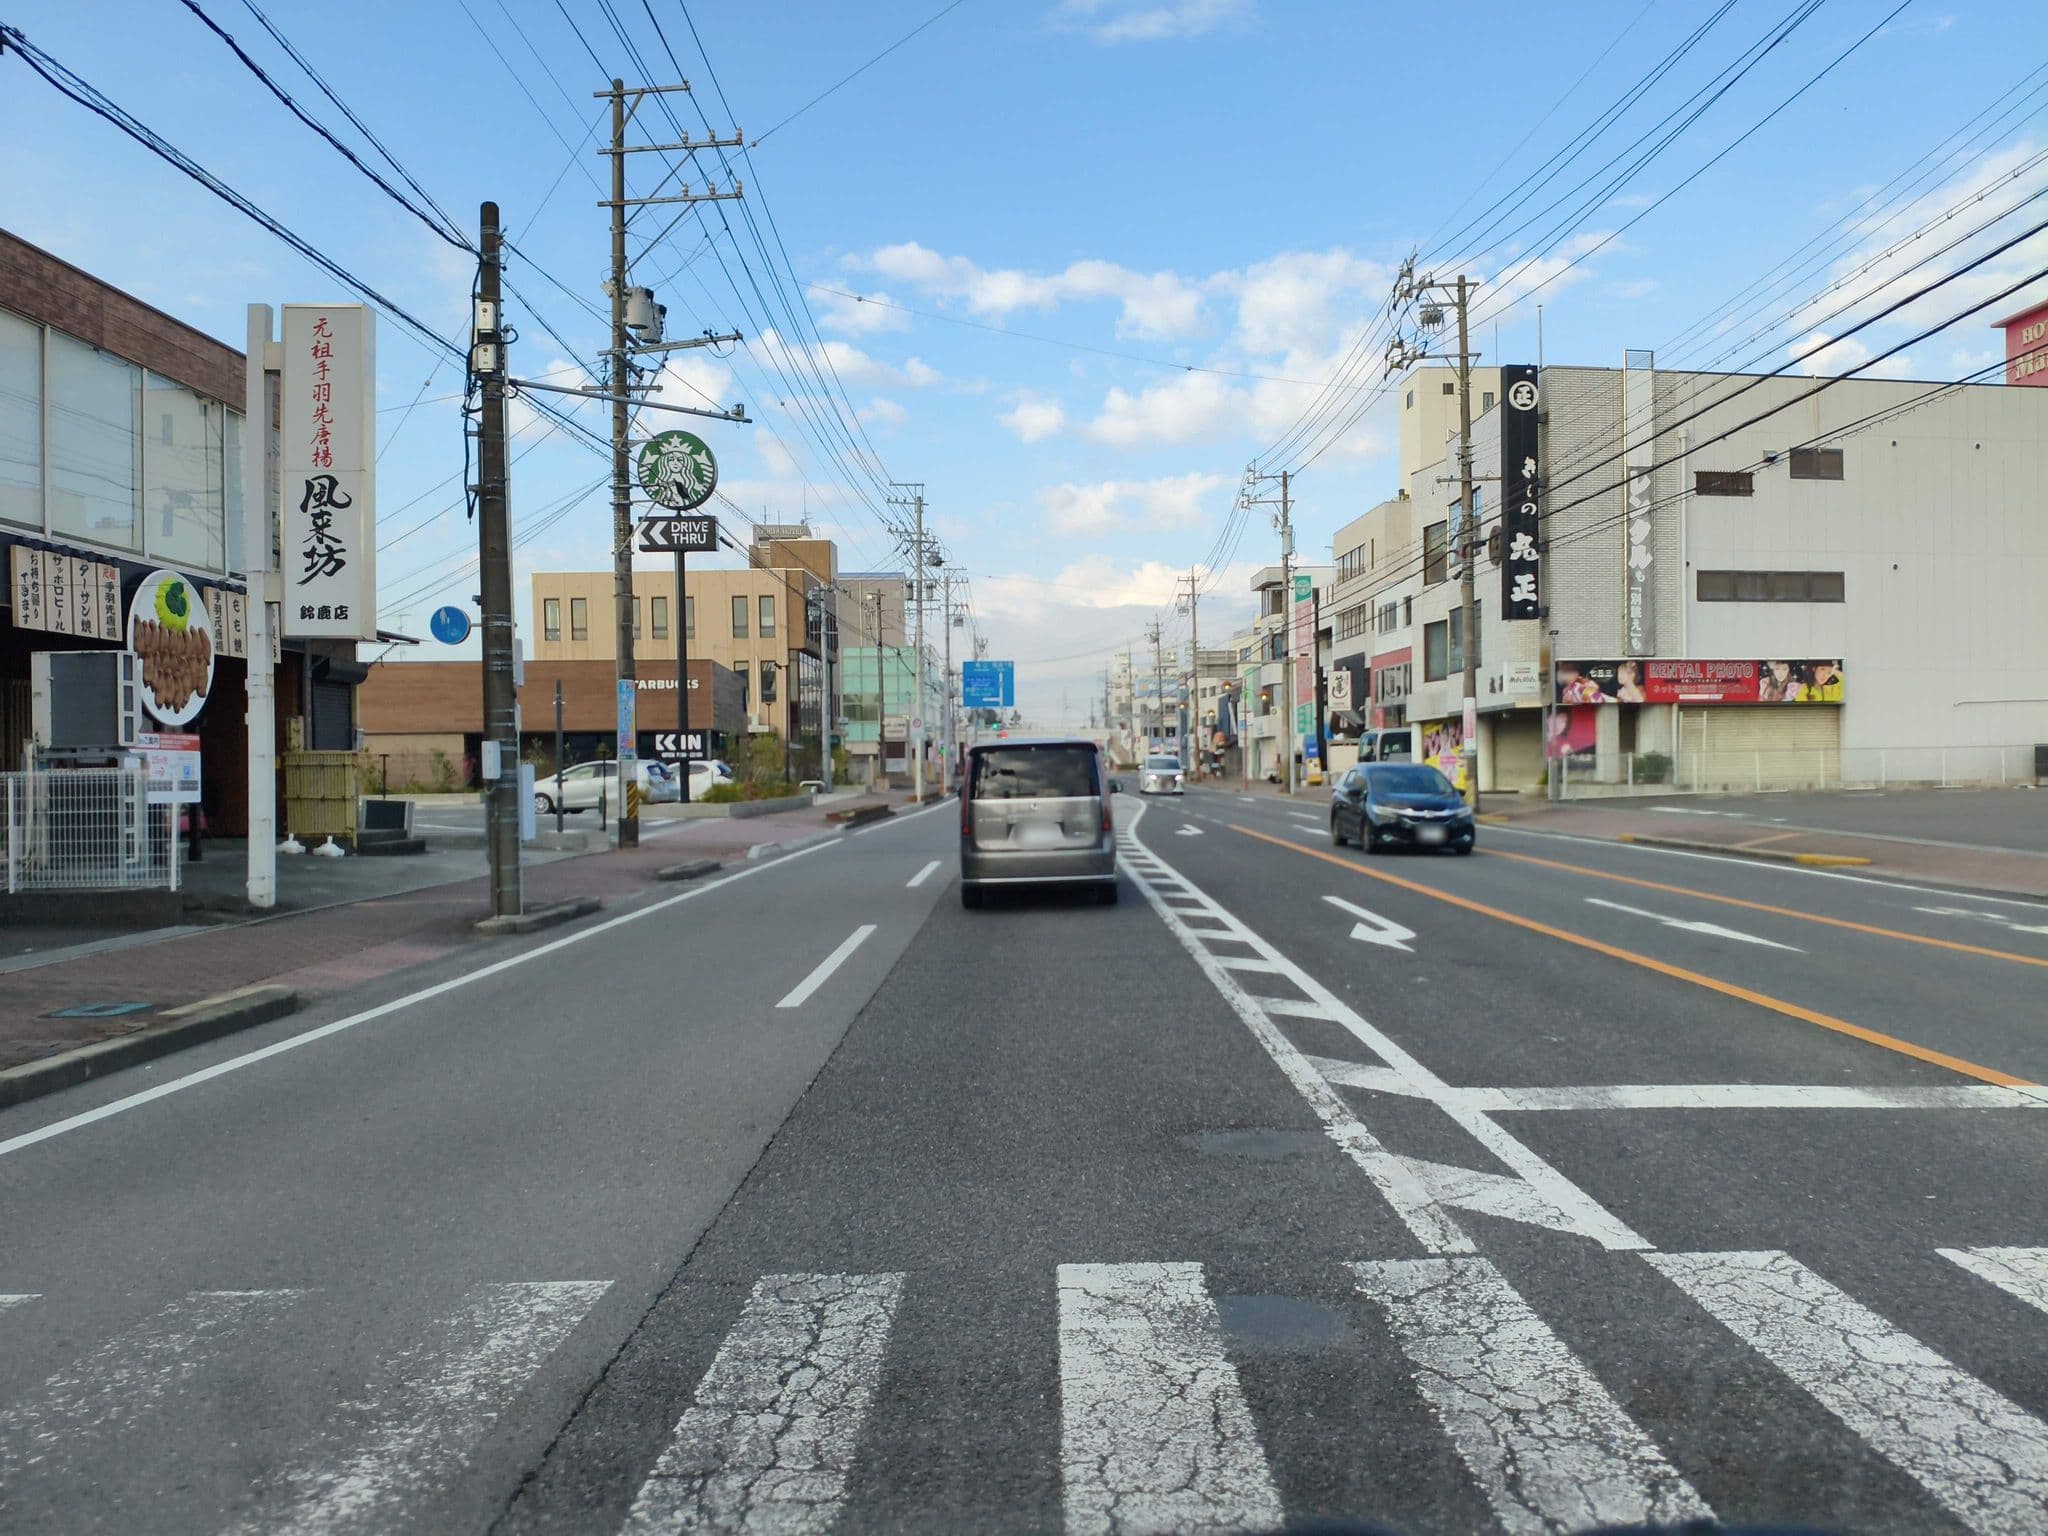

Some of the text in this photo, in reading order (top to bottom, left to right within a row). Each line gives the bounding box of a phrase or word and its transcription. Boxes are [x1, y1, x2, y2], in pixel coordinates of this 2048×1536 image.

[311, 317, 334, 469] 元祖手羽先唐揚
[296, 474, 352, 585] 風来坊
[671, 521, 709, 532] DRIVE
[671, 533, 706, 544] THRU
[300, 605, 349, 620] 鈴鹿店
[1649, 662, 1754, 679] RENTAL PHOTO
[680, 734, 701, 750] IN
